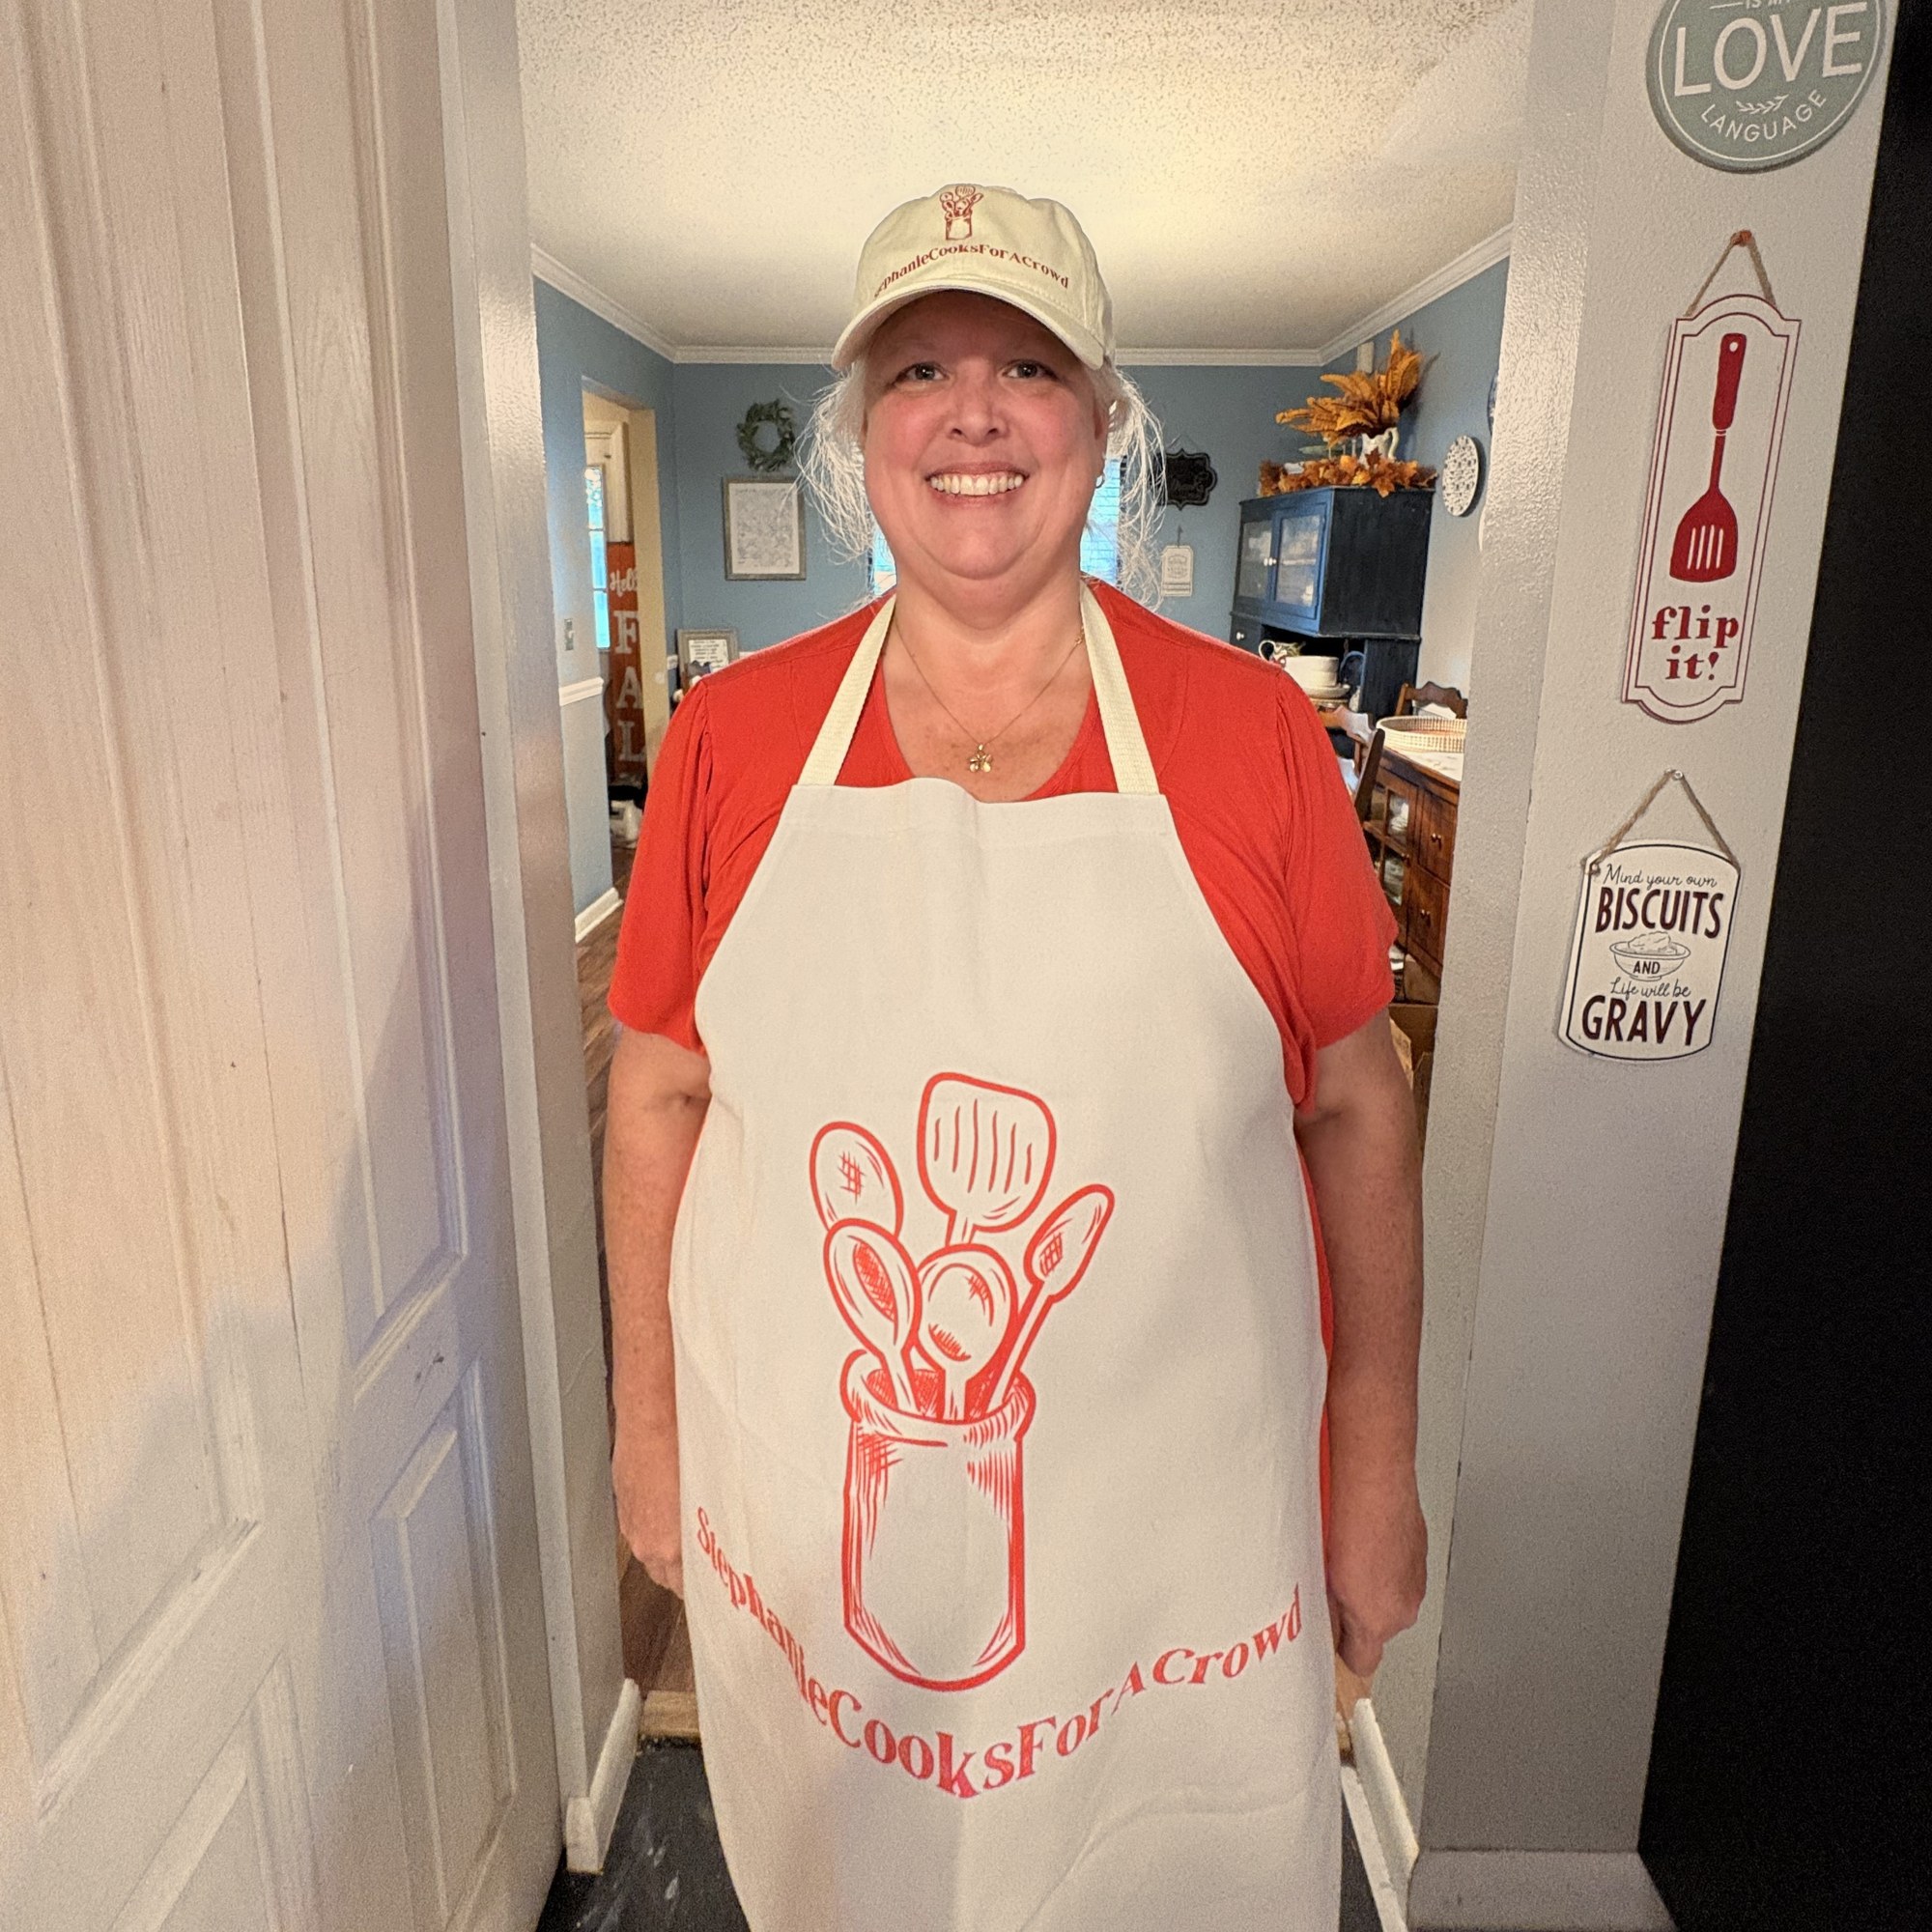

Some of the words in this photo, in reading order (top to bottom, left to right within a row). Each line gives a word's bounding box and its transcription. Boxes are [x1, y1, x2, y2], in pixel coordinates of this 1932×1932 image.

[1673, 1, 1868, 97] LOVE
[1700, 89, 1828, 143] LANGUAGE
[610, 567, 639, 598] Hell
[1651, 604, 1740, 649] flip
[1664, 644, 1720, 681] it!
[1603, 863, 1644, 886] Mind
[1646, 875, 1683, 891] your
[1686, 875, 1719, 889] own
[1595, 886, 1724, 939] BISCUITS
[1633, 960, 1661, 976] AND
[1610, 976, 1639, 1002] Life
[1640, 982, 1671, 999] will
[1672, 978, 1692, 998] be
[1581, 994, 1708, 1047] GRAVY
